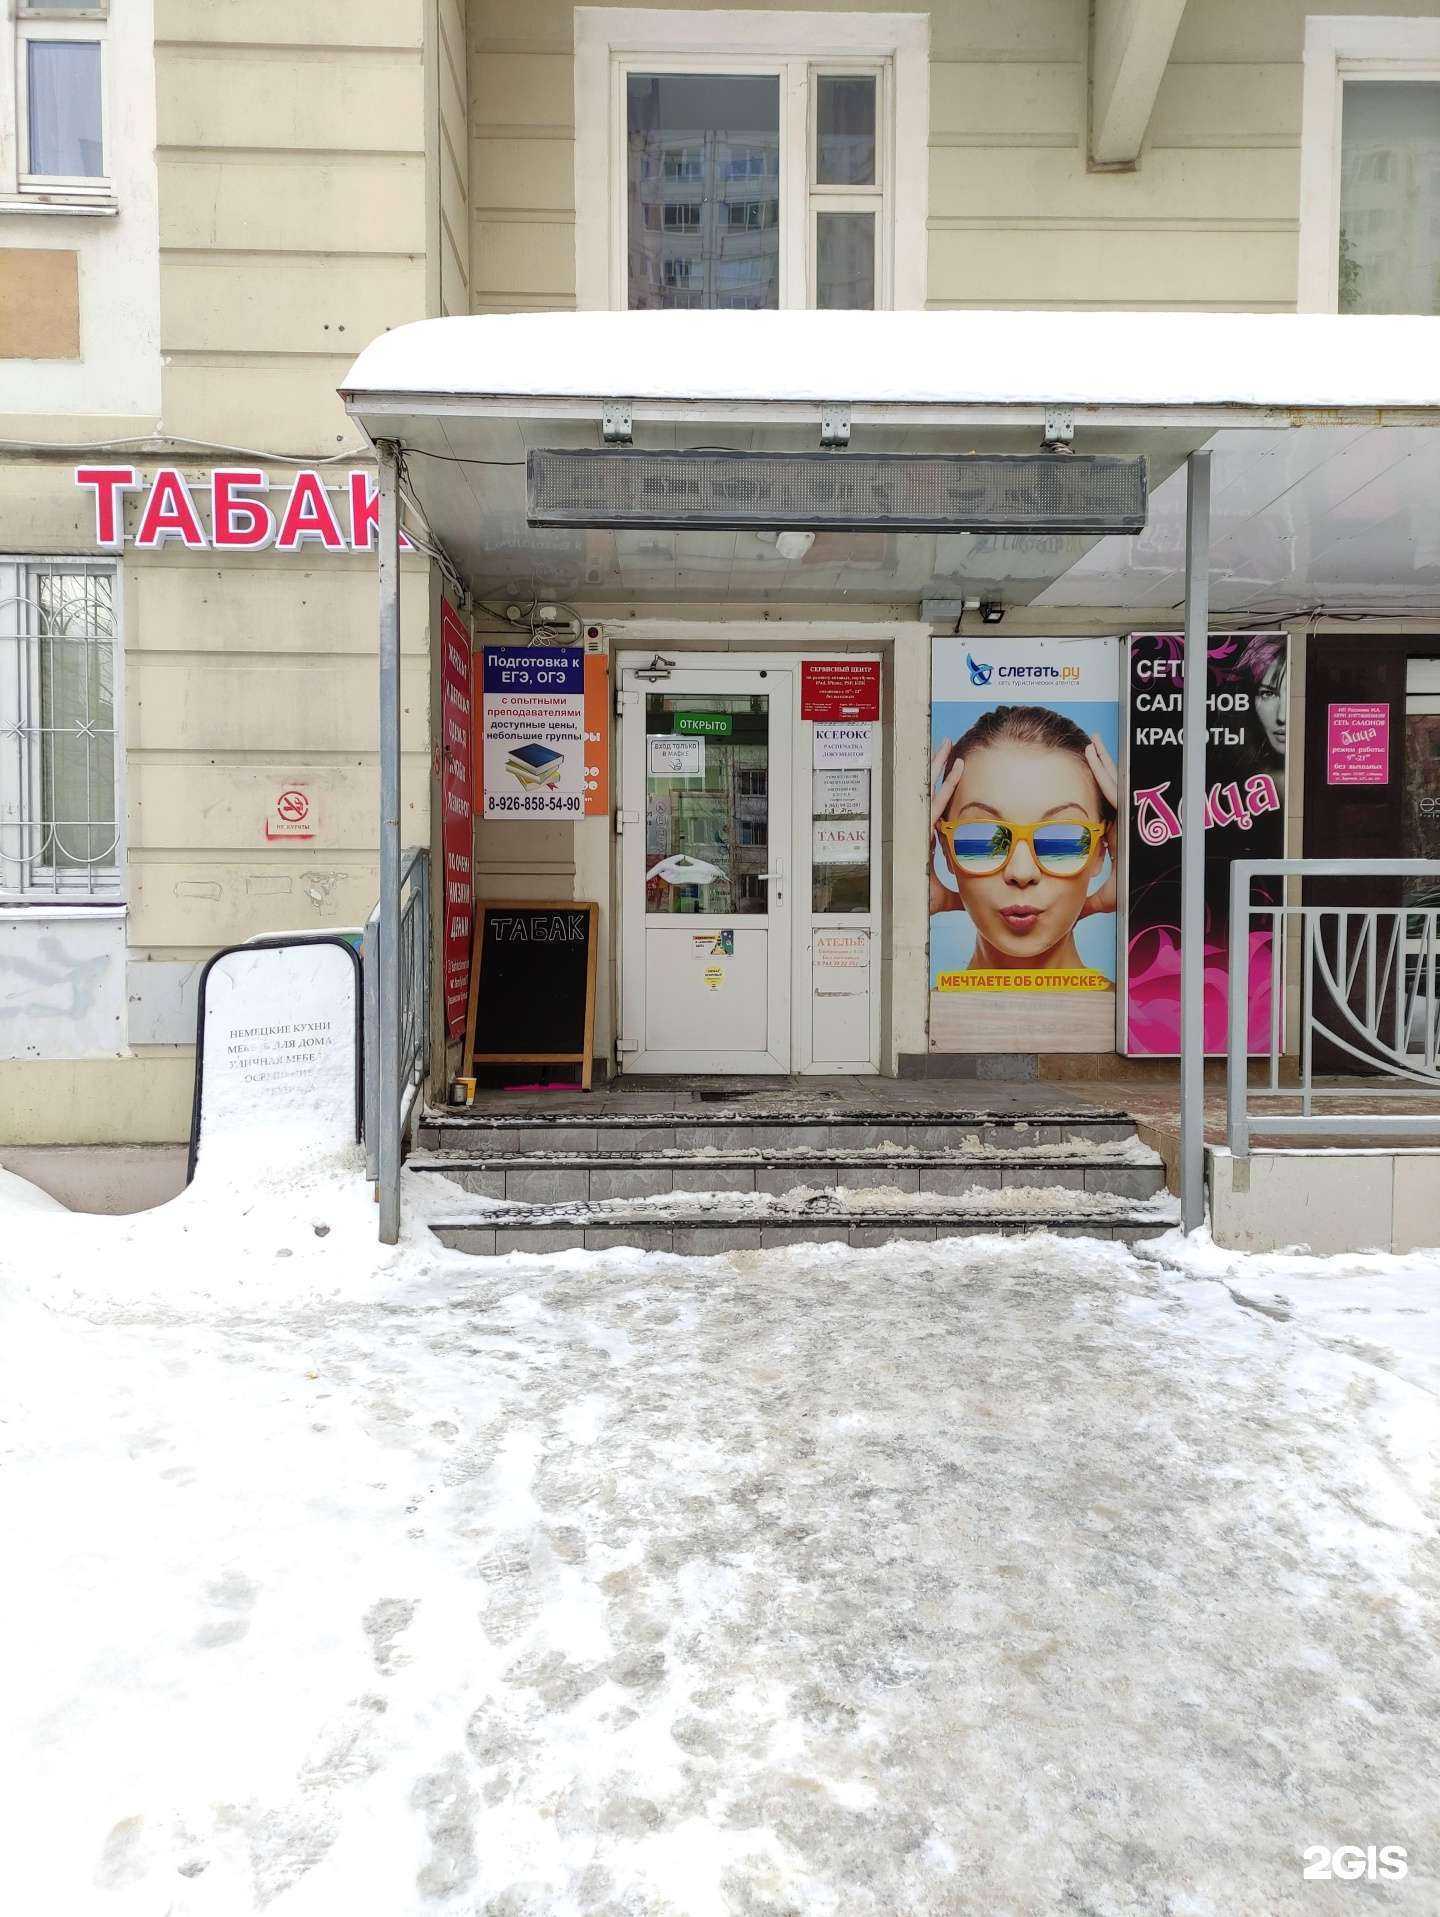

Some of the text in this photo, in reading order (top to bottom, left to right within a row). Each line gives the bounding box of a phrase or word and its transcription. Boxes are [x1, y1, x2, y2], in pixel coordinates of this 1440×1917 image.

[75, 465, 415, 552] ТАБАК
[488, 655, 580, 668] Подготовка к
[501, 671, 566, 685] ЕГЭ, ОГЭ
[998, 666, 1080, 680] слетать.ру
[510, 697, 567, 705] опытными
[1136, 693, 1250, 712] САЛНОВ
[487, 708, 581, 718] преподавателями
[490, 721, 578, 731] доступные цены,
[679, 719, 727, 731] ОТКРЫТО
[1351, 719, 1386, 727] САЛОНОВ
[486, 731, 543, 741] небольшие
[545, 732, 582, 742] группы
[816, 730, 872, 740] КСЕРОКС
[1136, 727, 1245, 746] КРАТЫ
[488, 796, 581, 811] 8-926-858-54-90
[817, 830, 866, 842] ТАБАК
[491, 915, 585, 941] ТАБАК
[941, 975, 1105, 987] МЕЧТАЕТЕ ОБ ОТПУСКЕ?
[229, 1021, 331, 1039] НЕМЕЦКИЕ КУХНИ
